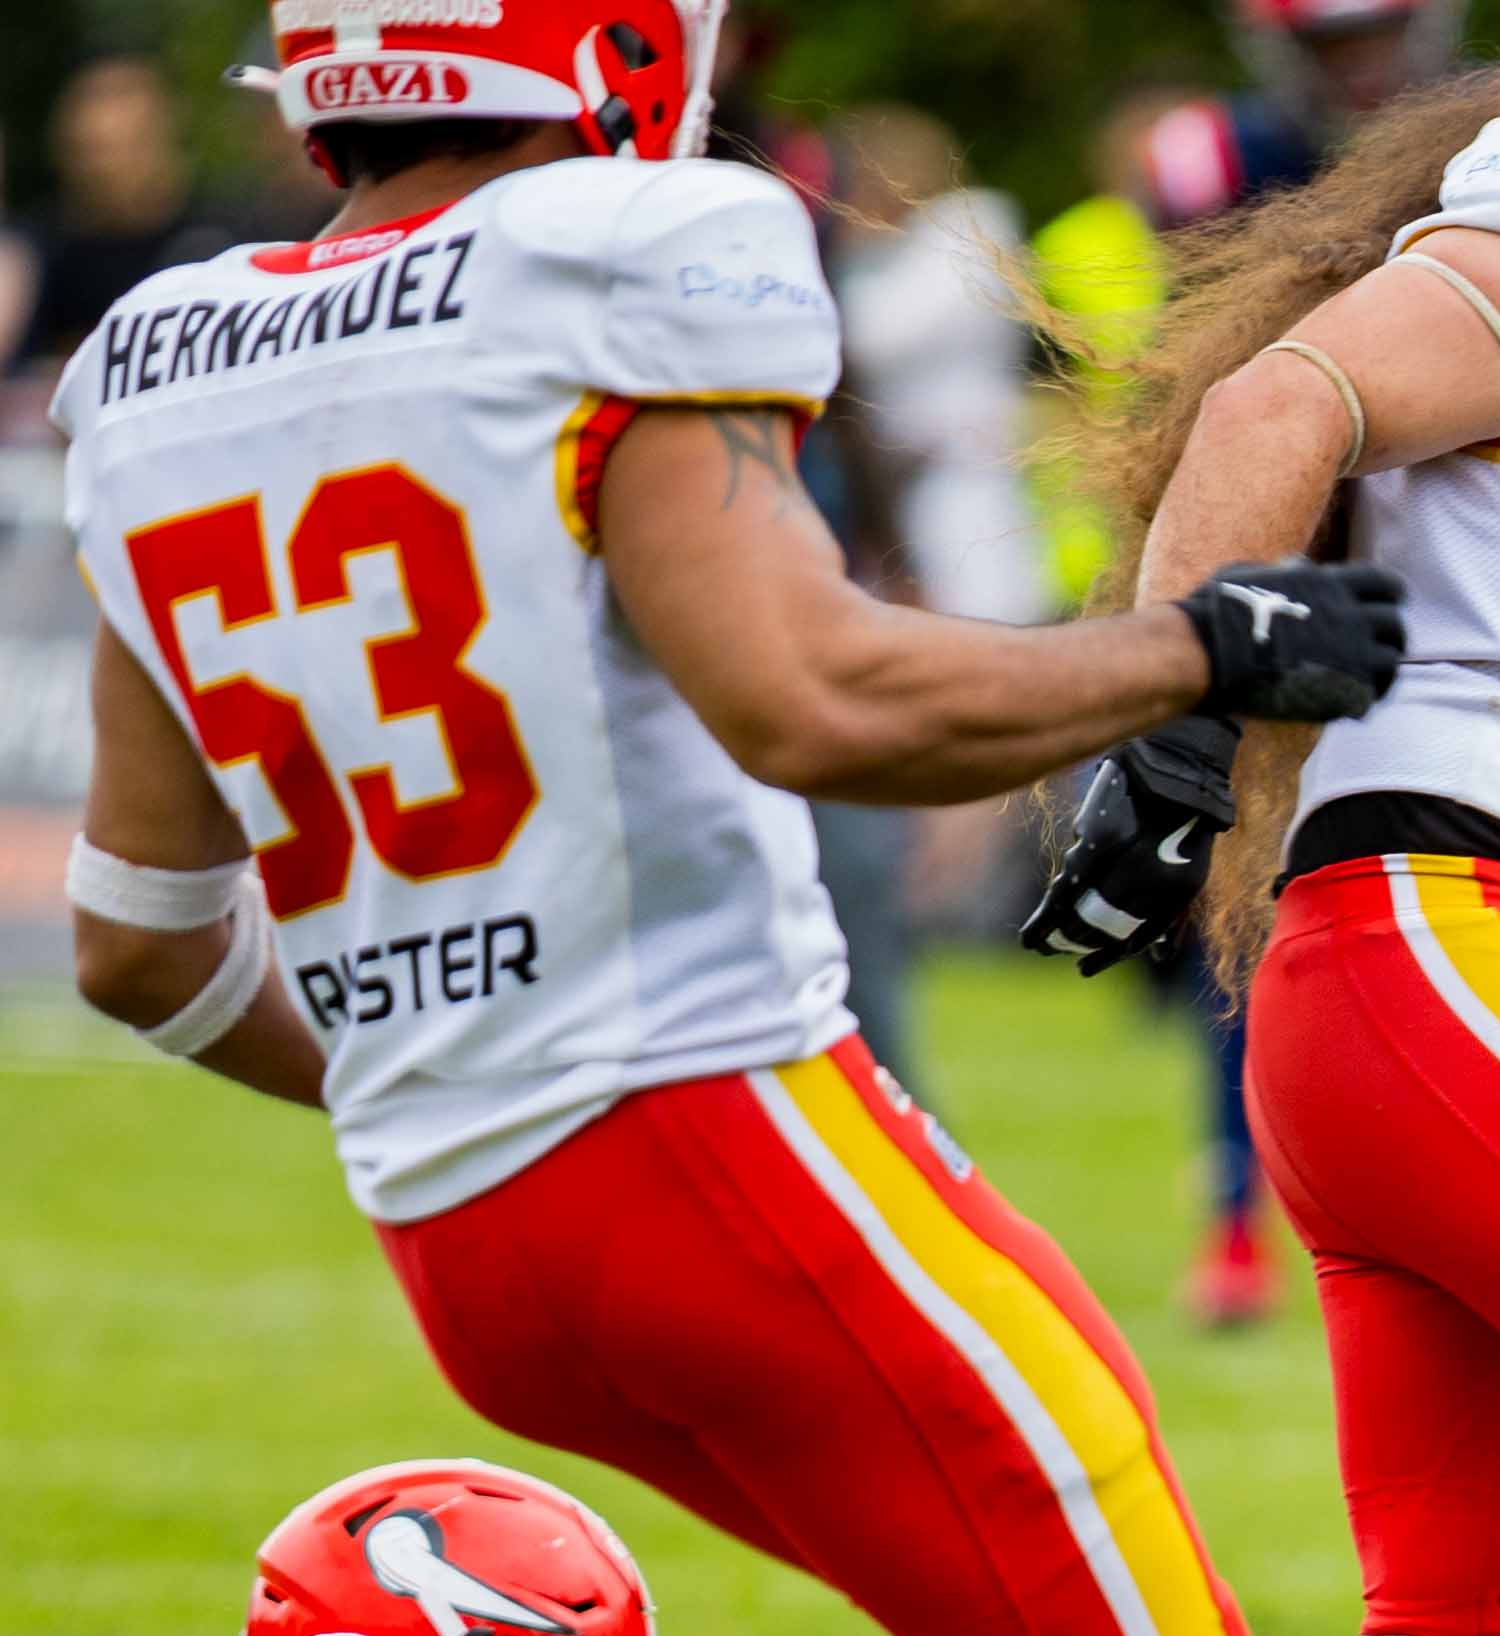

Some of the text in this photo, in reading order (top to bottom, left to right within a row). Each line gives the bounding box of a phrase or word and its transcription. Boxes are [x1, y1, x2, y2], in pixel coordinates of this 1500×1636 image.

[312, 61, 454, 107] GAZI
[102, 231, 479, 406] HERNANDEZ
[122, 460, 541, 923] 53
